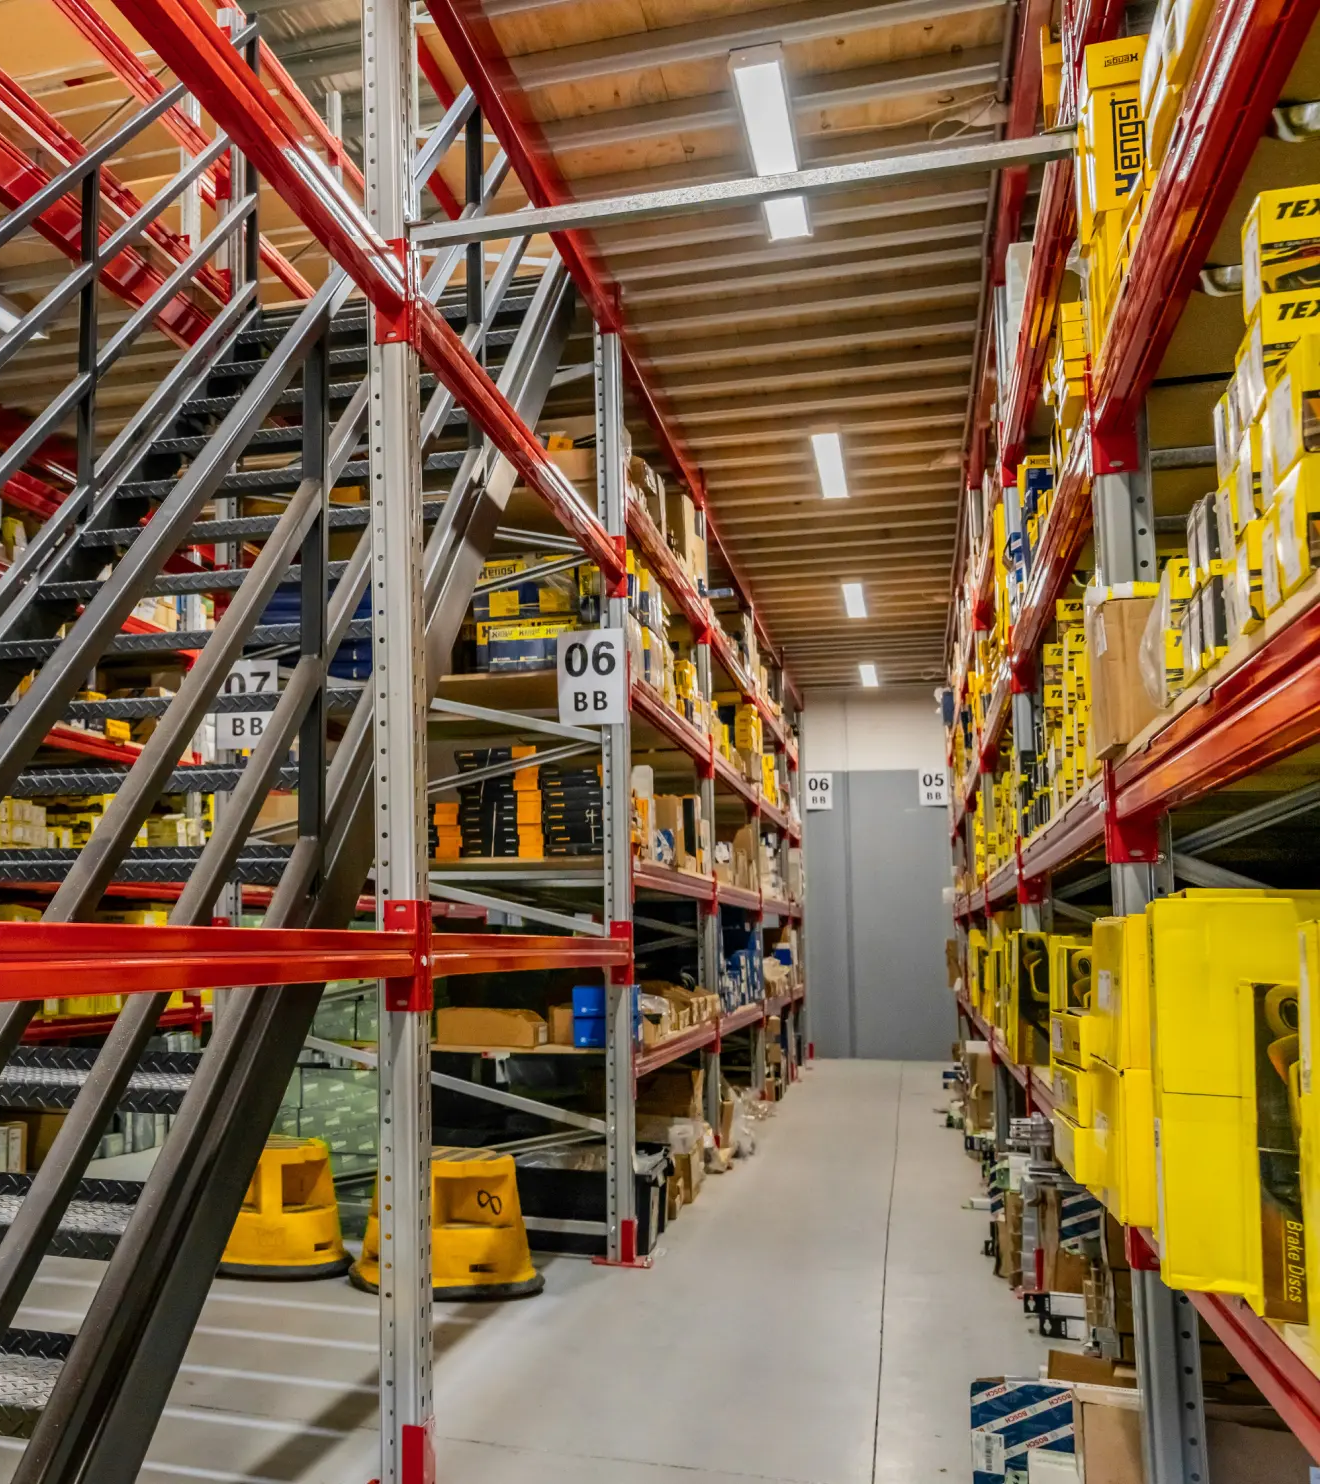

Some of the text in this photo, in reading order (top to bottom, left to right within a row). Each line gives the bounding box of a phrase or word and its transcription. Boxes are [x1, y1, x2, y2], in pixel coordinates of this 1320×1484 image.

[1104, 53, 1139, 68] Hengst
[1110, 98, 1147, 196] Hengst
[565, 641, 616, 677] 06
[574, 690, 608, 712] BB
[231, 717, 263, 736] BB
[808, 778, 829, 791] 06
[922, 773, 945, 787] 05
[812, 796, 826, 804] BB
[926, 792, 942, 801] BB
[1286, 1219, 1305, 1303] Brake Discs
[1048, 1392, 1072, 1406] BOSCH
[1005, 1410, 1028, 1424] BOSCH
[1025, 1435, 1049, 1449] BOSCH
